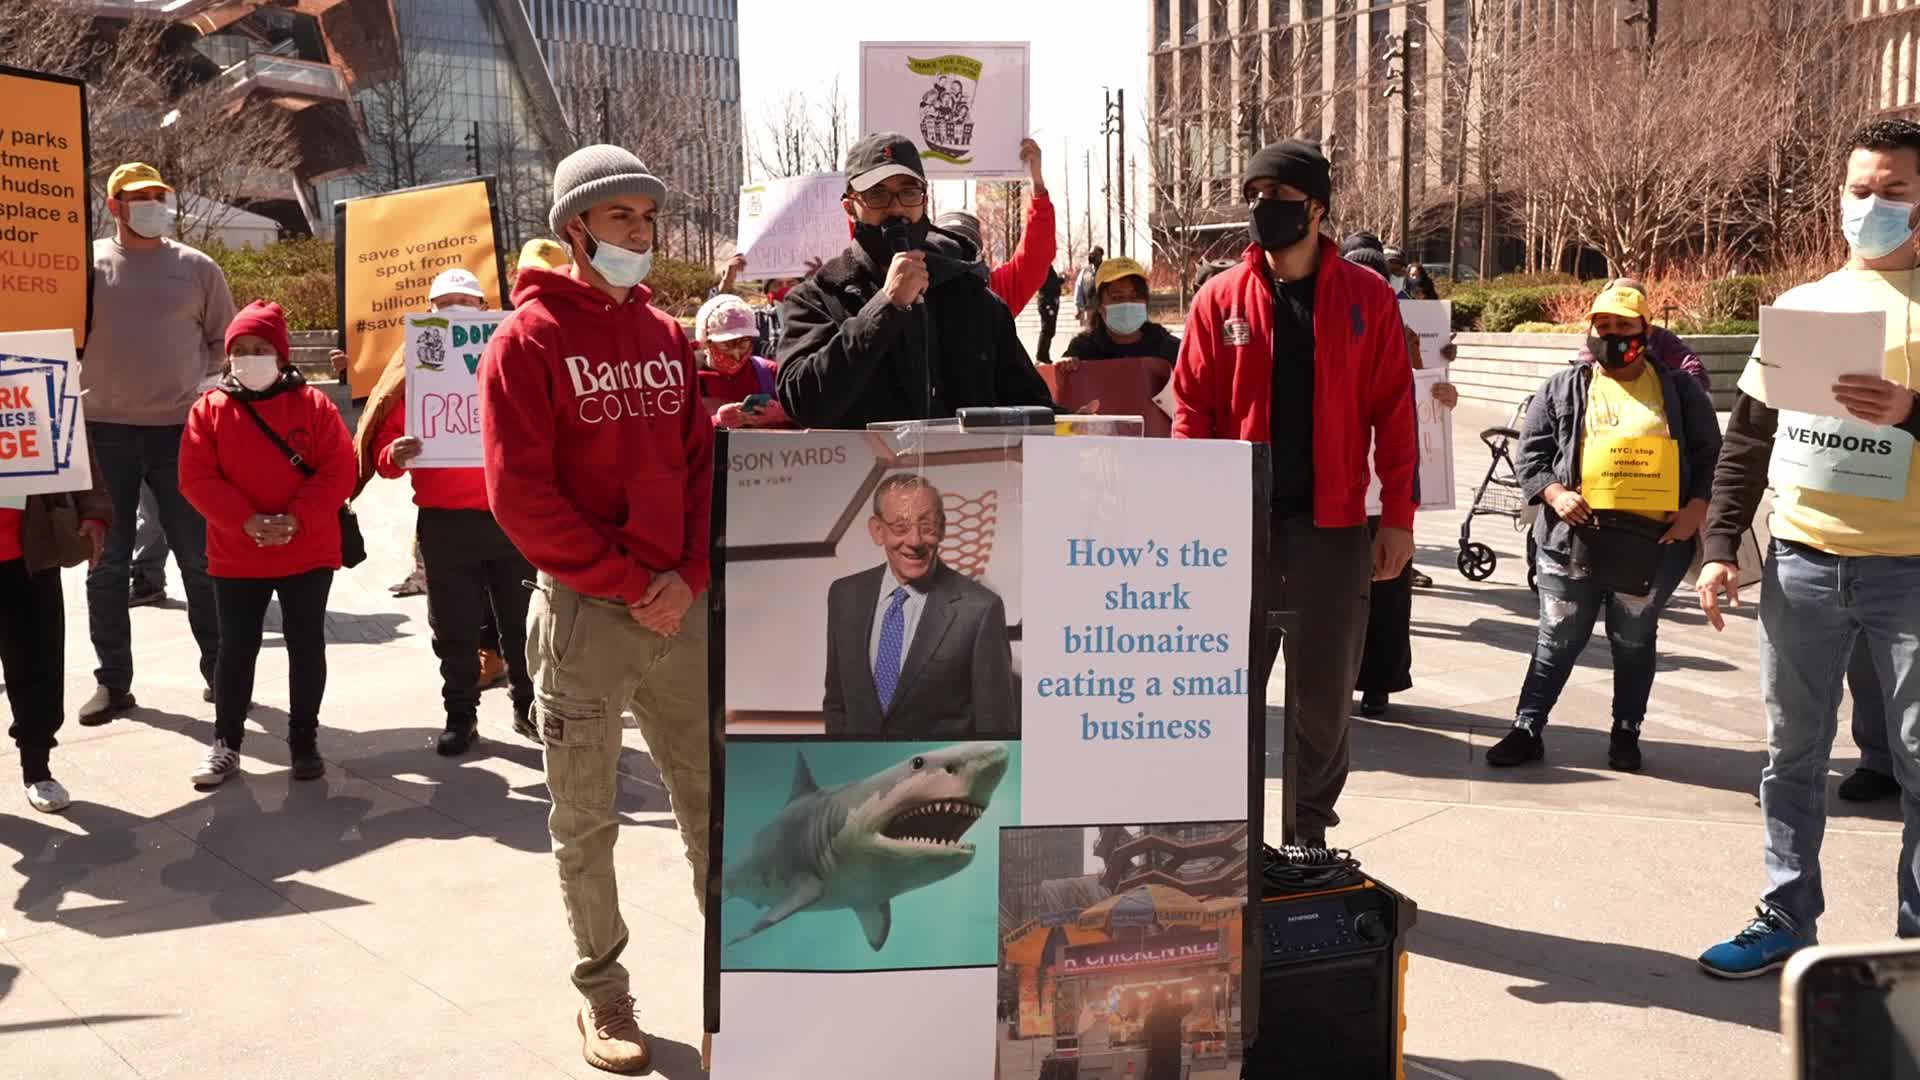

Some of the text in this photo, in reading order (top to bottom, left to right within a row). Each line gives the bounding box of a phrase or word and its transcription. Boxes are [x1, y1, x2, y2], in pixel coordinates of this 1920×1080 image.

[12, 130, 68, 150] parks
[1, 152, 60, 173] tment
[2, 175, 75, 199] hudson
[67, 210, 79, 224] a
[0, 225, 39, 243] dor
[358, 235, 478, 263] save vendors
[376, 253, 462, 278] spot from
[2, 273, 57, 294] KERS
[395, 273, 439, 291] shar
[372, 295, 429, 313] billion
[564, 351, 685, 397] Baruch
[0, 429, 41, 460] GE
[1635, 447, 1655, 456] stop
[1787, 426, 1893, 456] VENDORS
[780, 445, 847, 469] YARDS
[1601, 471, 1661, 479] displacement
[1179, 539, 1229, 567] the
[1104, 582, 1193, 610] shark
[1063, 624, 1230, 654] billonaires
[1037, 667, 1249, 704] eating a small
[1080, 711, 1212, 740] business
